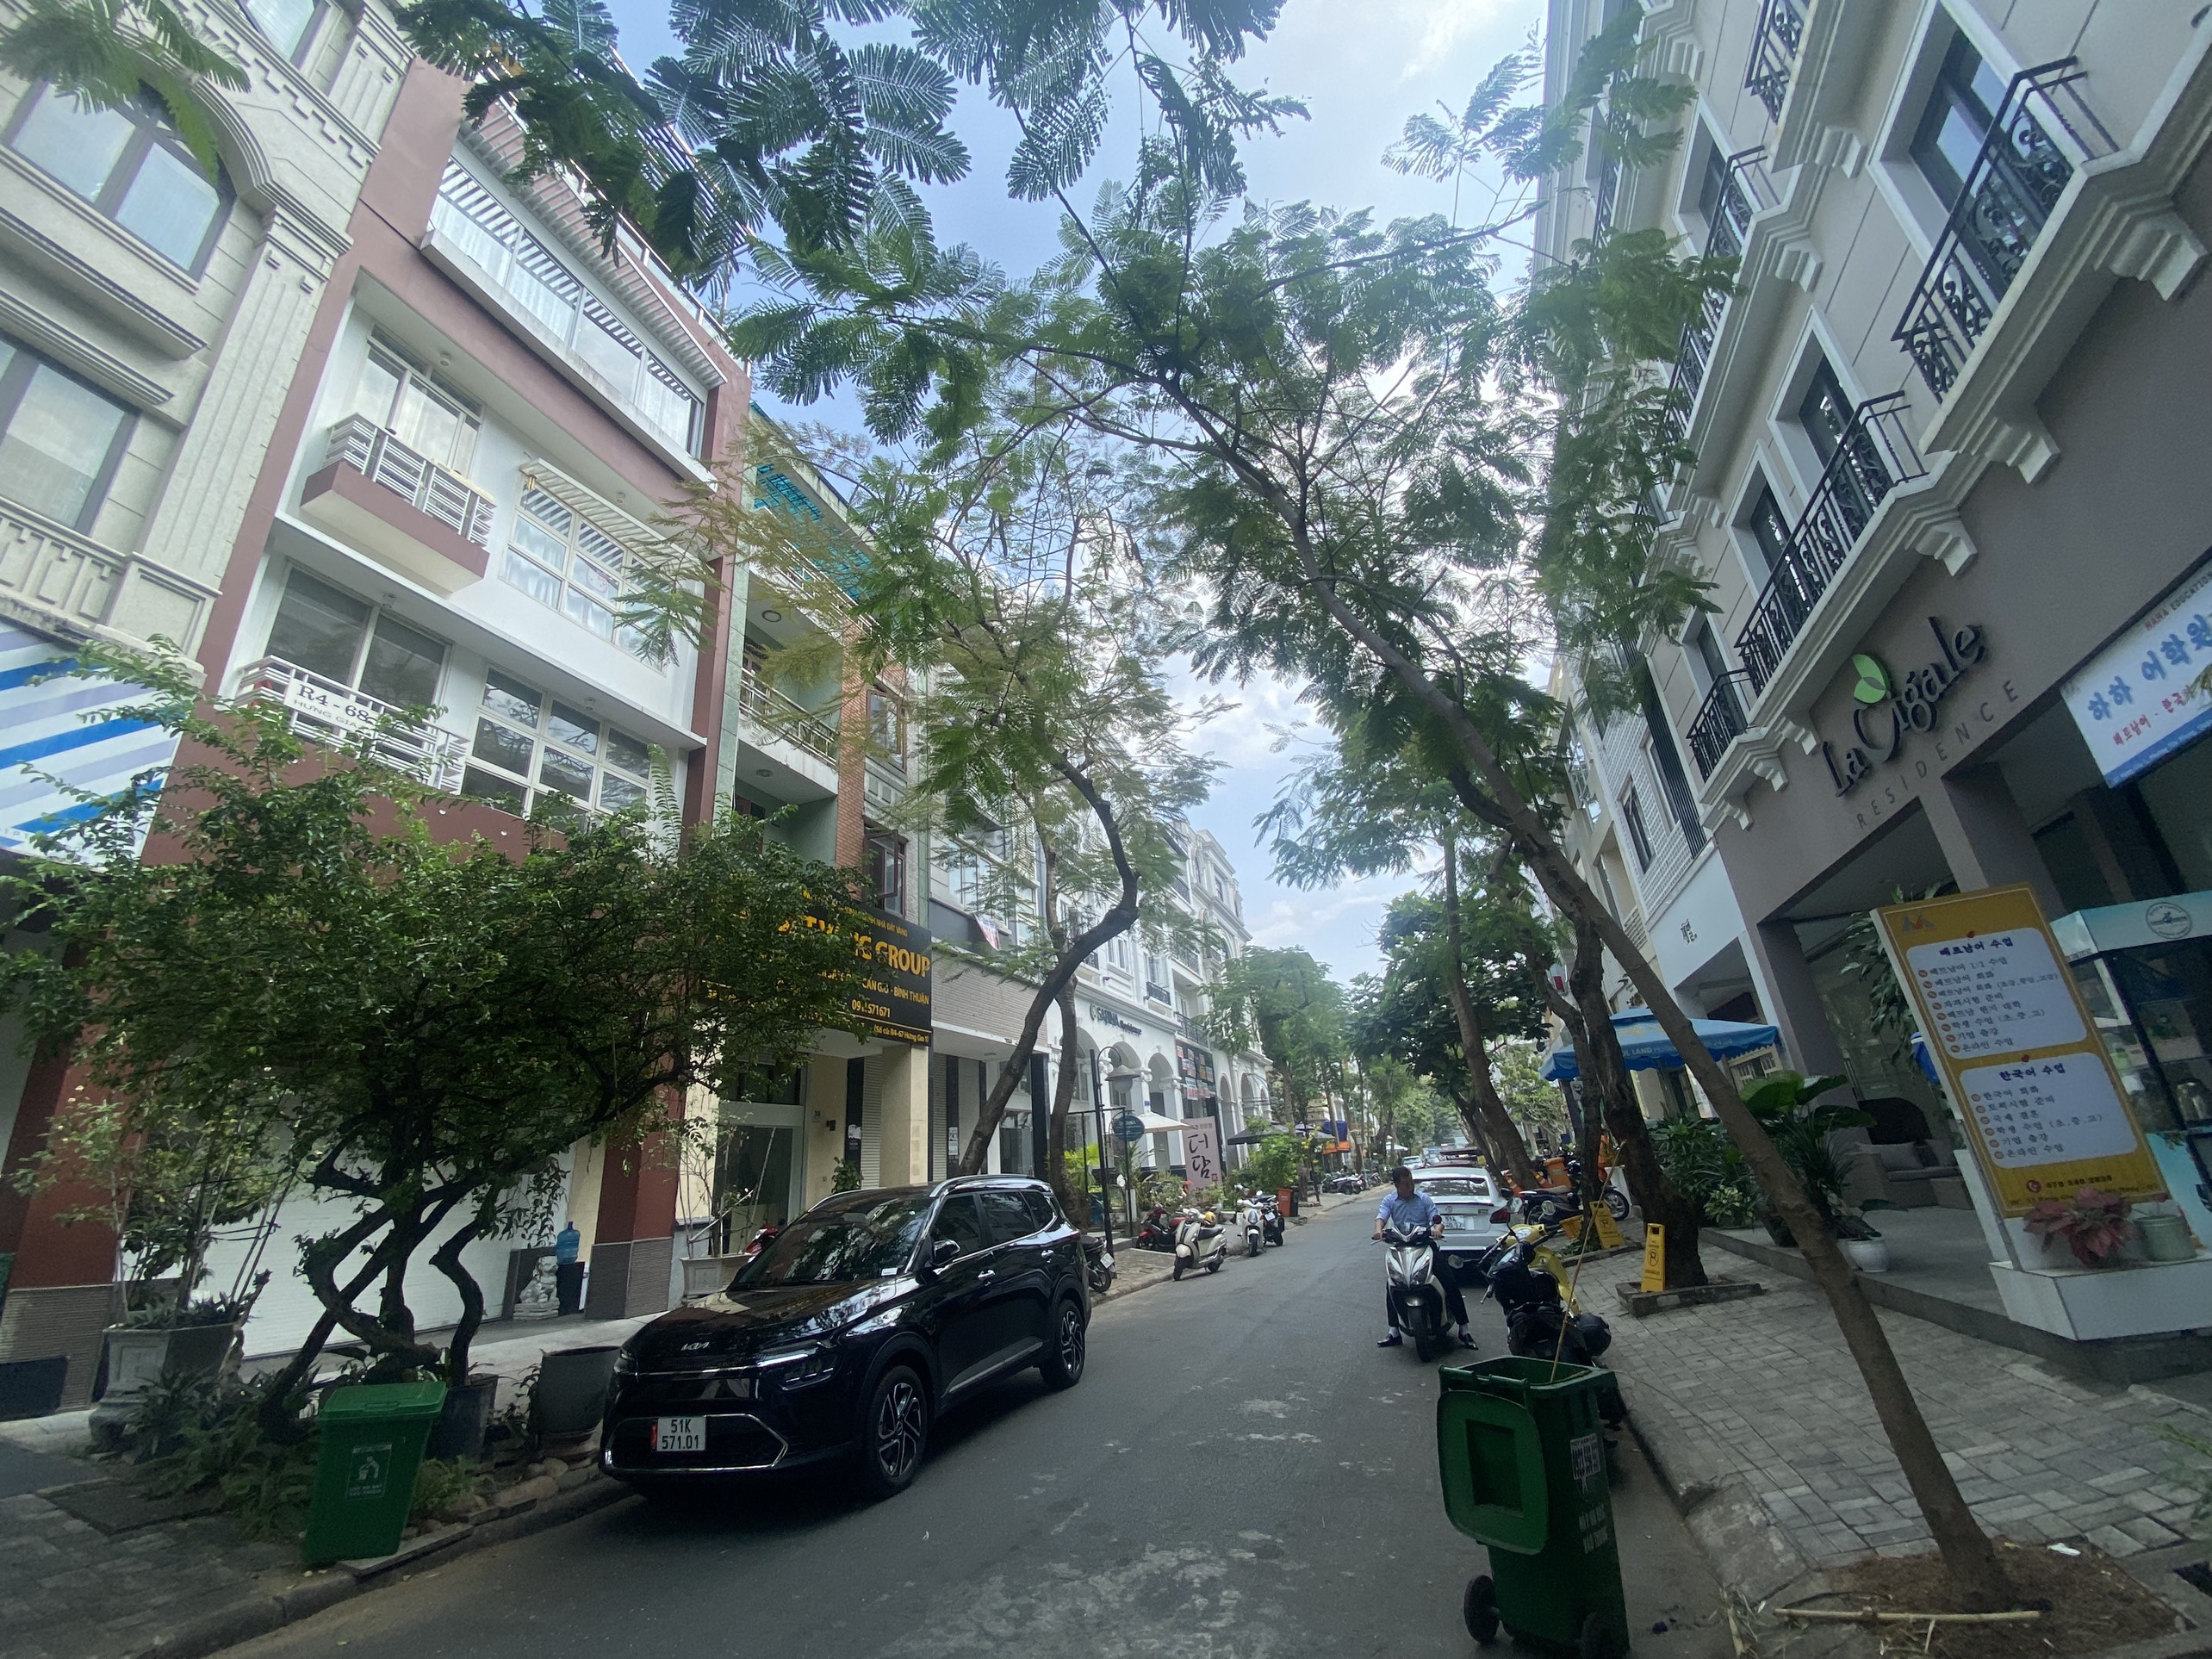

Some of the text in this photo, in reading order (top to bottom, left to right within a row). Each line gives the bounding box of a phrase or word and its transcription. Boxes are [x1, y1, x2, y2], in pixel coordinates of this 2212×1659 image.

[2088, 614, 2212, 721] 하하 어학원
[297, 684, 328, 706] R4
[294, 699, 357, 729] HƯNG GIA
[1855, 679, 2021, 830] RESIDENCE
[1822, 741, 1870, 798] La
[1939, 936, 2014, 956] 베트남어 수업
[874, 941, 931, 978] GROUP
[1989, 957, 2008, 966] 수업
[893, 985, 909, 1000] BÌNH
[909, 990, 929, 1006] THUẬN
[1975, 1016, 1994, 1026] 수업
[1957, 1031, 1975, 1041] 기업
[1961, 1037, 2014, 1053] 온라인 수업
[1999, 1063, 2066, 1082] 한국어 수업
[1982, 1089, 2013, 1101] 한국어
[2022, 1122, 2044, 1131] 수업
[2001, 1136, 2022, 1146] 기업
[2006, 1143, 2065, 1159] 온라인 수업
[670, 1419, 692, 1433] 51K
[662, 1435, 699, 1450] 571.01
